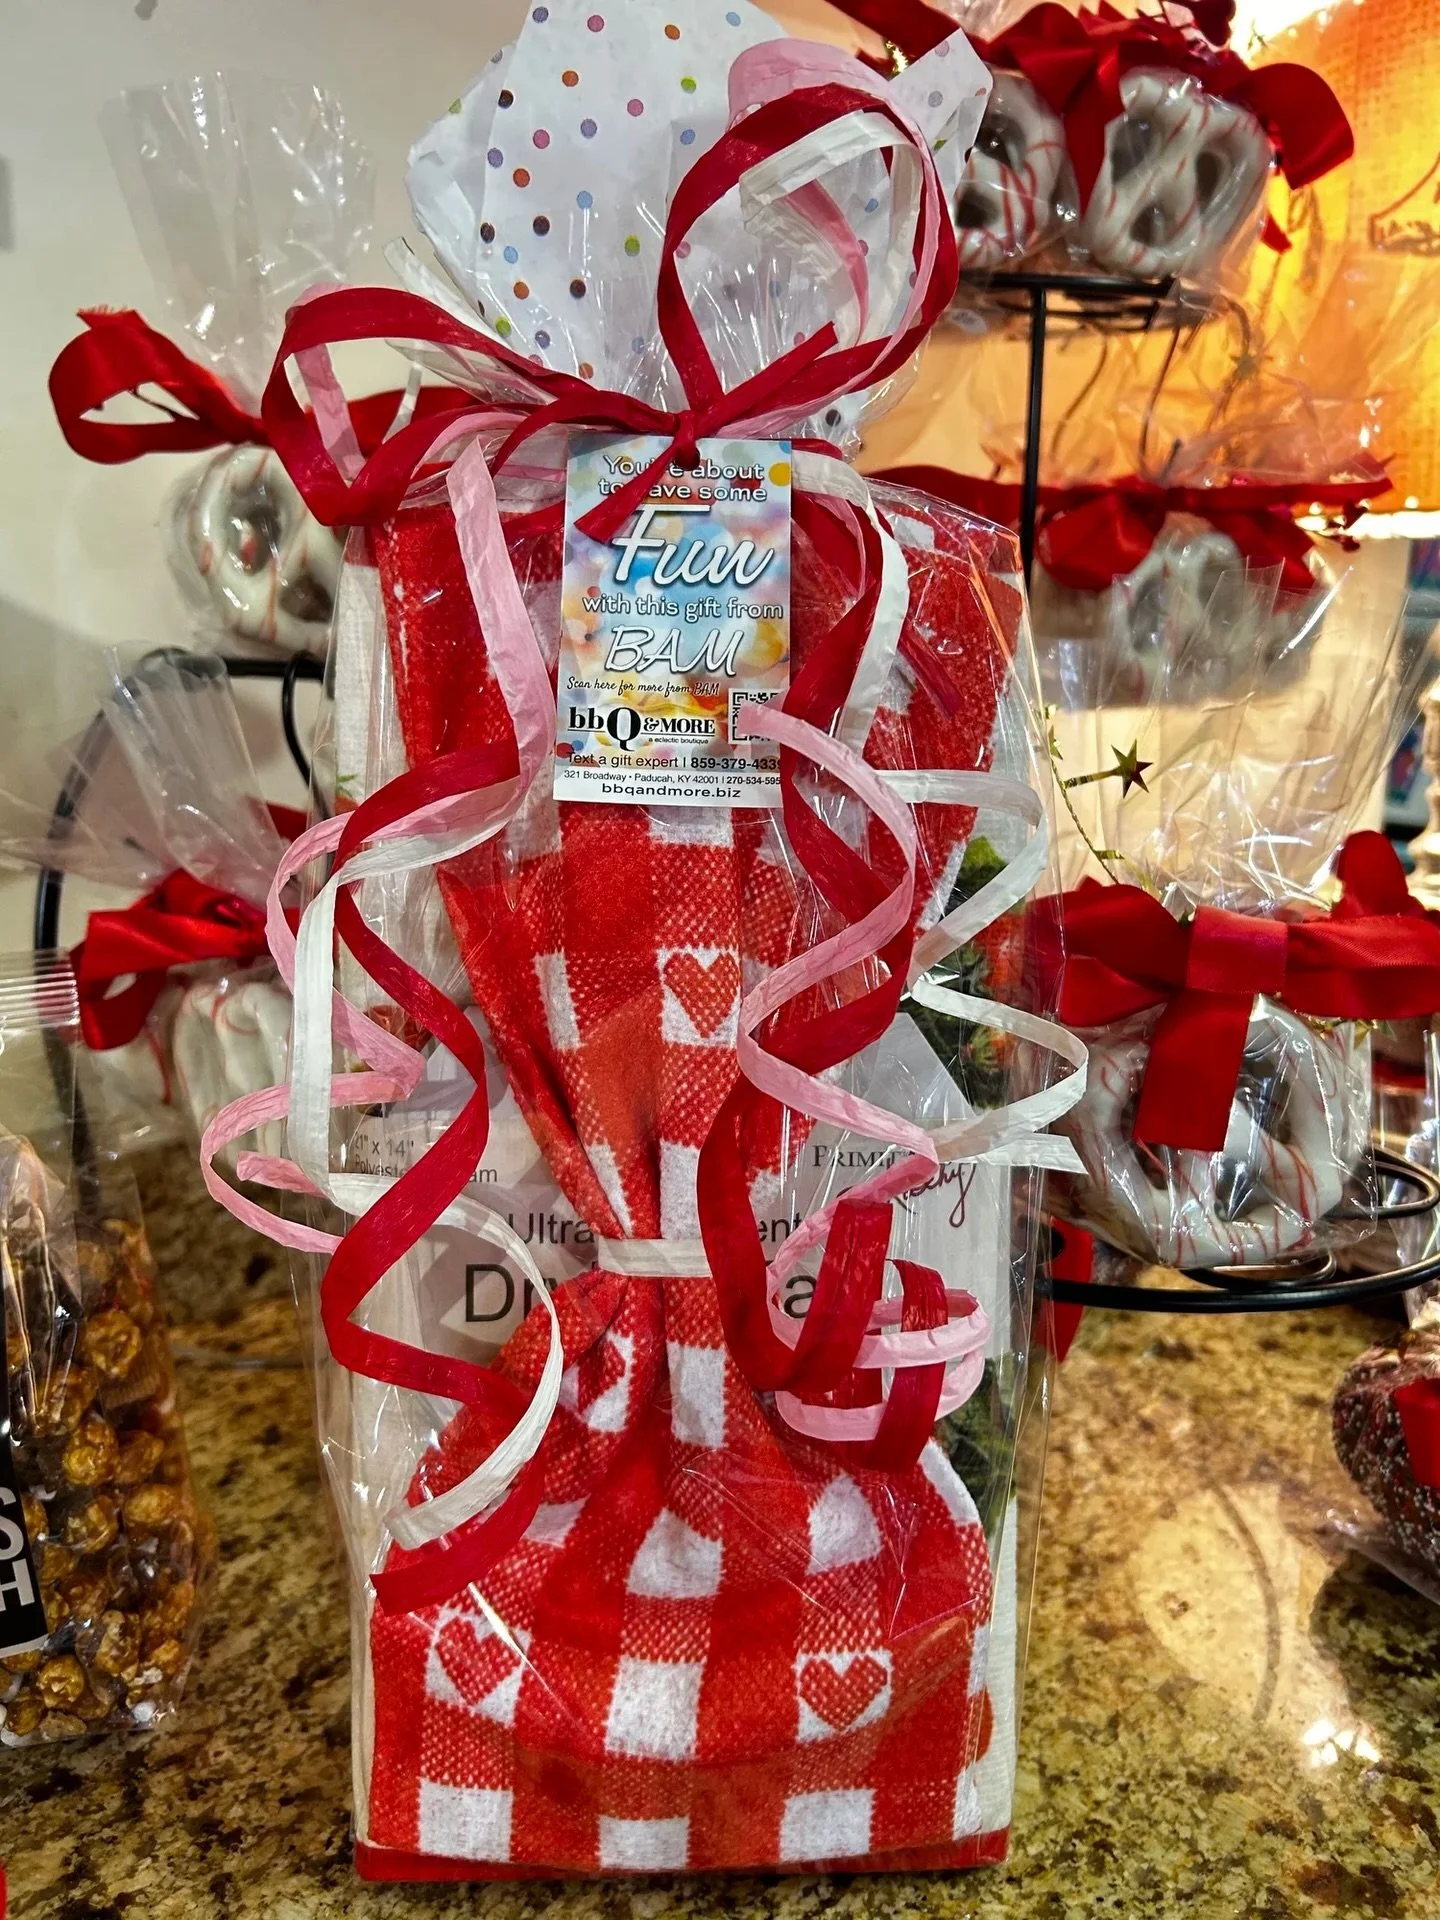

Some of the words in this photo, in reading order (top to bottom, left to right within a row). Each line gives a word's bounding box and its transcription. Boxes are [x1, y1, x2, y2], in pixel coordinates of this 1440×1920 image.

[603, 455, 683, 477] You'e
[692, 459, 765, 479] about
[650, 485, 692, 499] ave
[699, 488, 767, 501] some
[611, 504, 775, 586] Fun
[583, 593, 630, 614] with
[636, 593, 679, 617] this
[685, 596, 721, 623] gift
[728, 597, 784, 619] from
[604, 625, 745, 676] BAM
[567, 676, 592, 690] Scan
[593, 679, 617, 691] here
[617, 680, 636, 696] for
[637, 684, 664, 693] more
[664, 681, 692, 697] from
[693, 682, 720, 696] BAM
[680, 737, 709, 745] boutique
[567, 752, 595, 764] Text
[598, 756, 607, 765] a
[611, 754, 632, 768] gift
[636, 756, 679, 770] expert
[564, 770, 580, 779] 321
[583, 771, 627, 782] Broadway
[634, 773, 675, 784] Paducah,
[677, 775, 691, 783] KY
[692, 775, 719, 784] 42001
[726, 776, 781, 785] 270-534-595
[602, 783, 741, 798] bbqandmore.biz
[508, 1212, 595, 1245] Ultra
